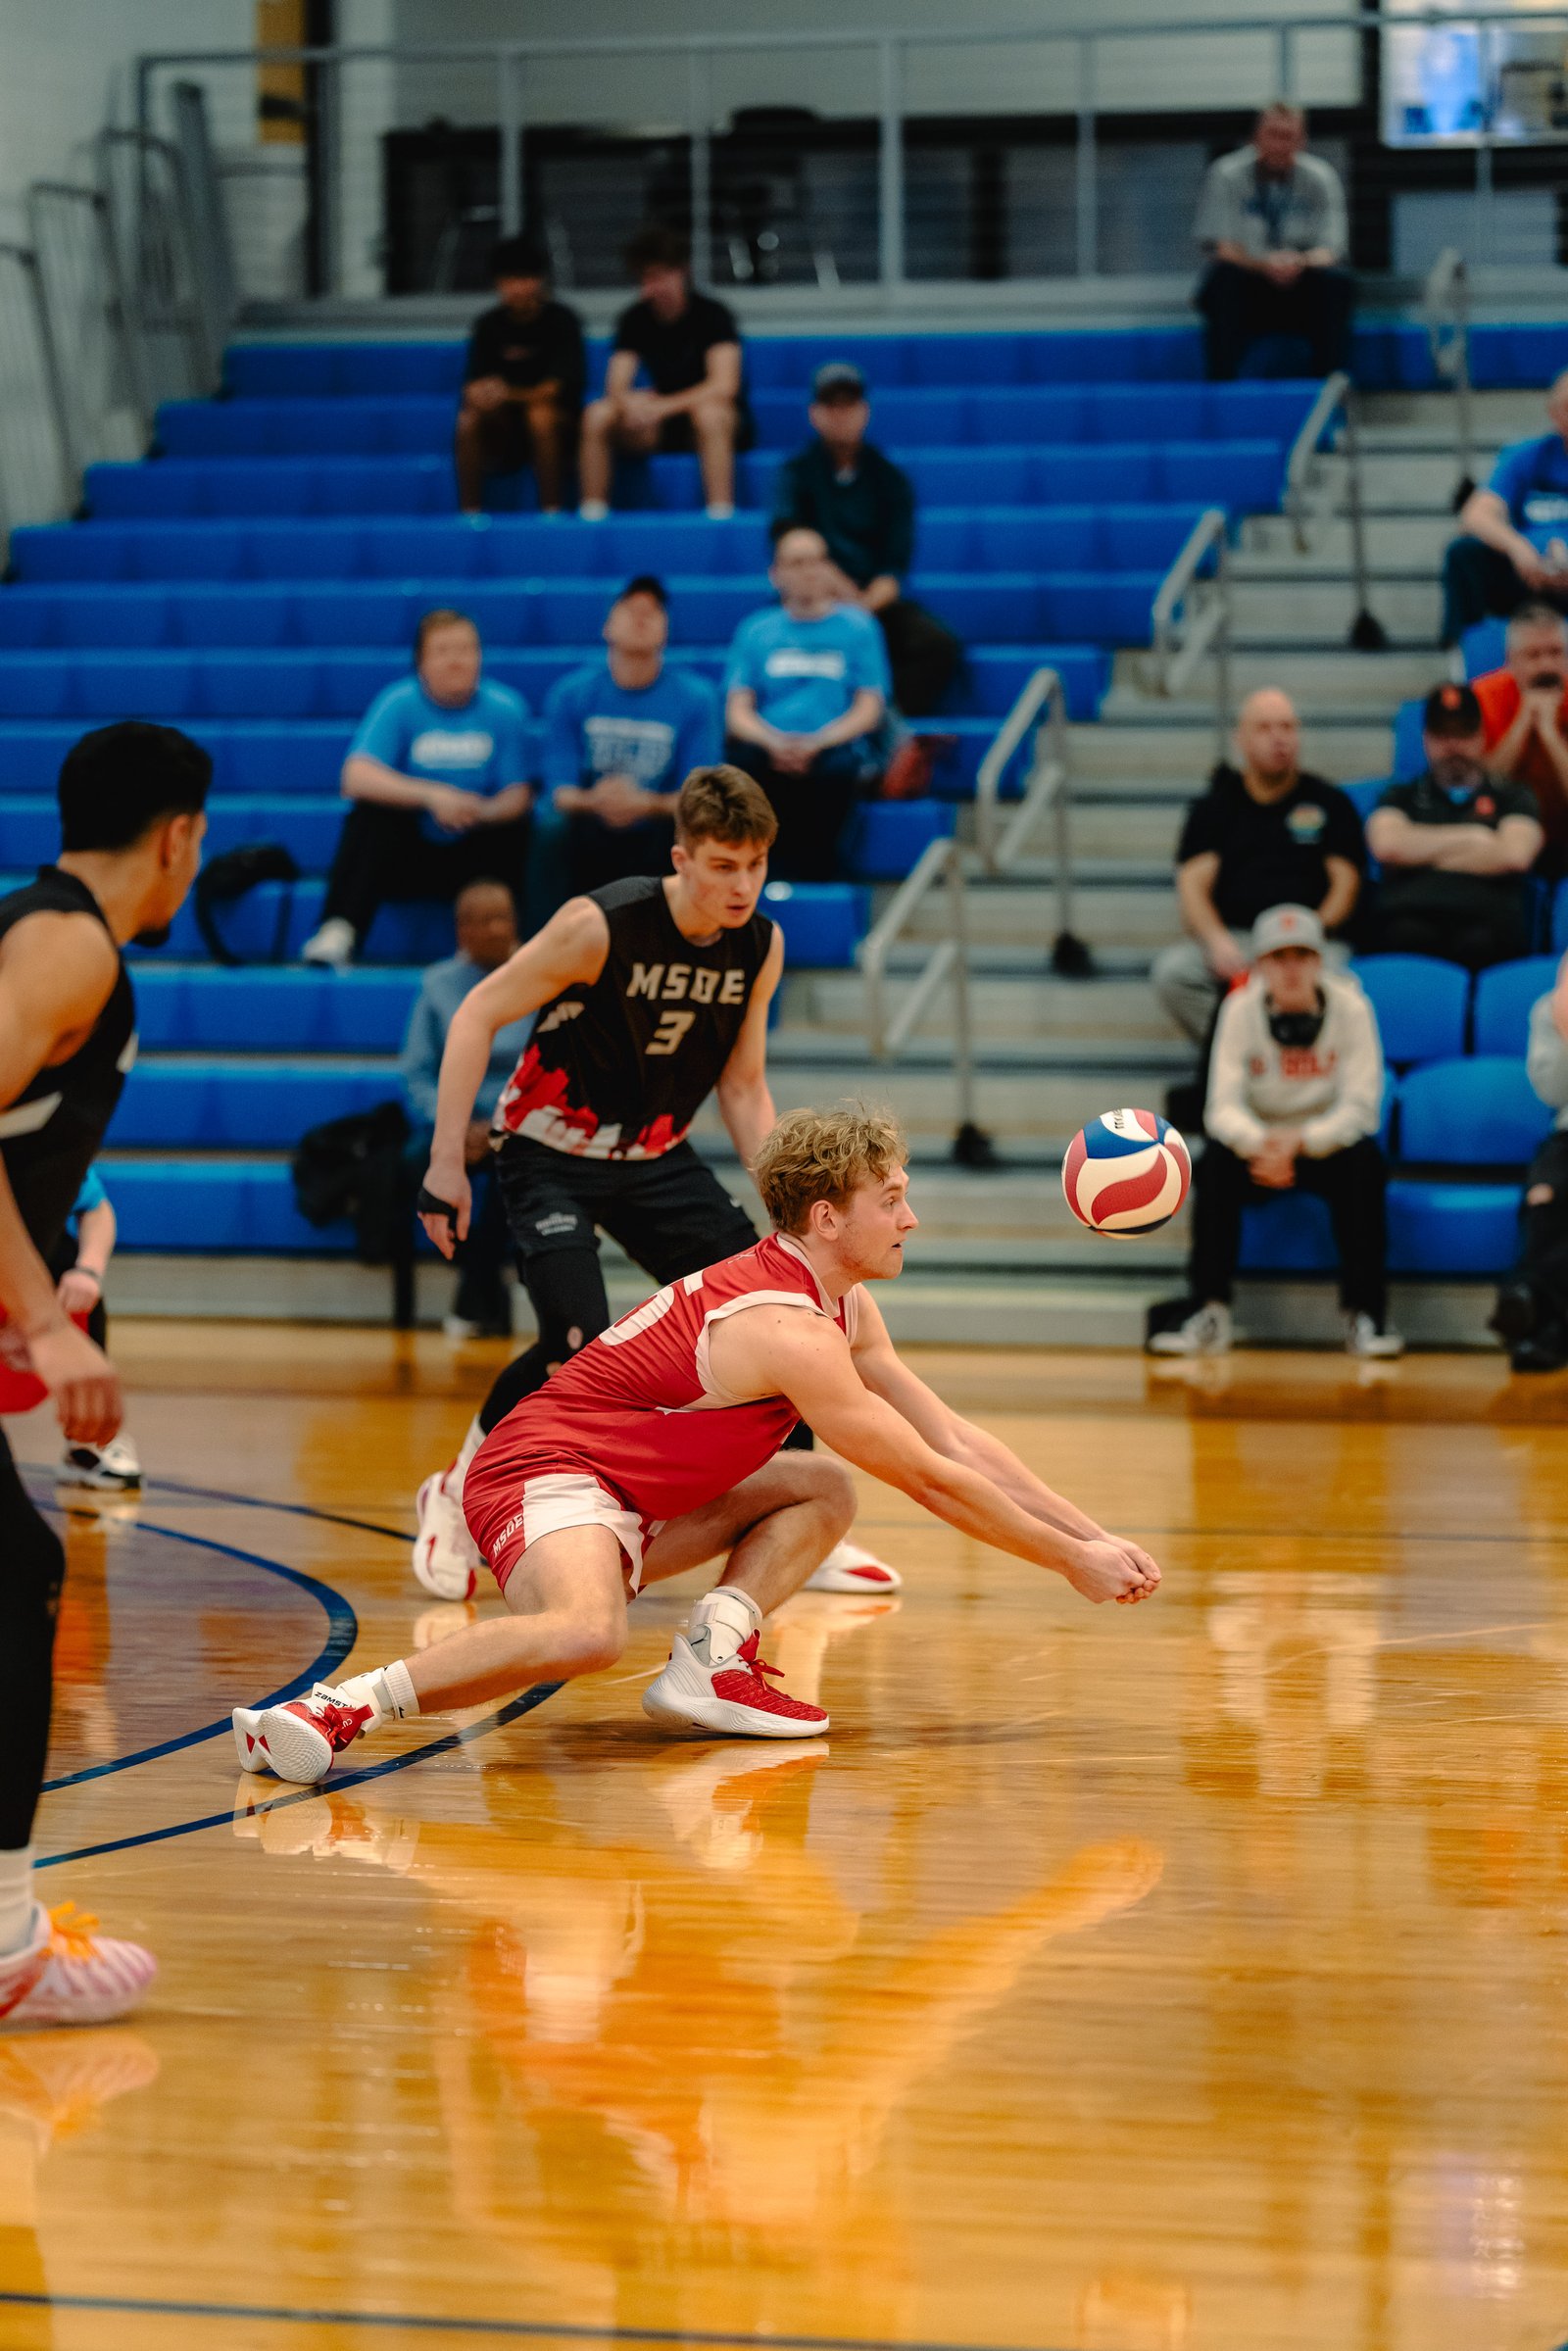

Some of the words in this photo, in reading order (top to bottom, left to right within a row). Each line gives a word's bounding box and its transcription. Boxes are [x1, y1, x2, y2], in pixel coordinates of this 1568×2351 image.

[625, 962, 745, 1004] MSOE
[645, 1010, 696, 1055] 3
[492, 1513, 523, 1558] MSOE
